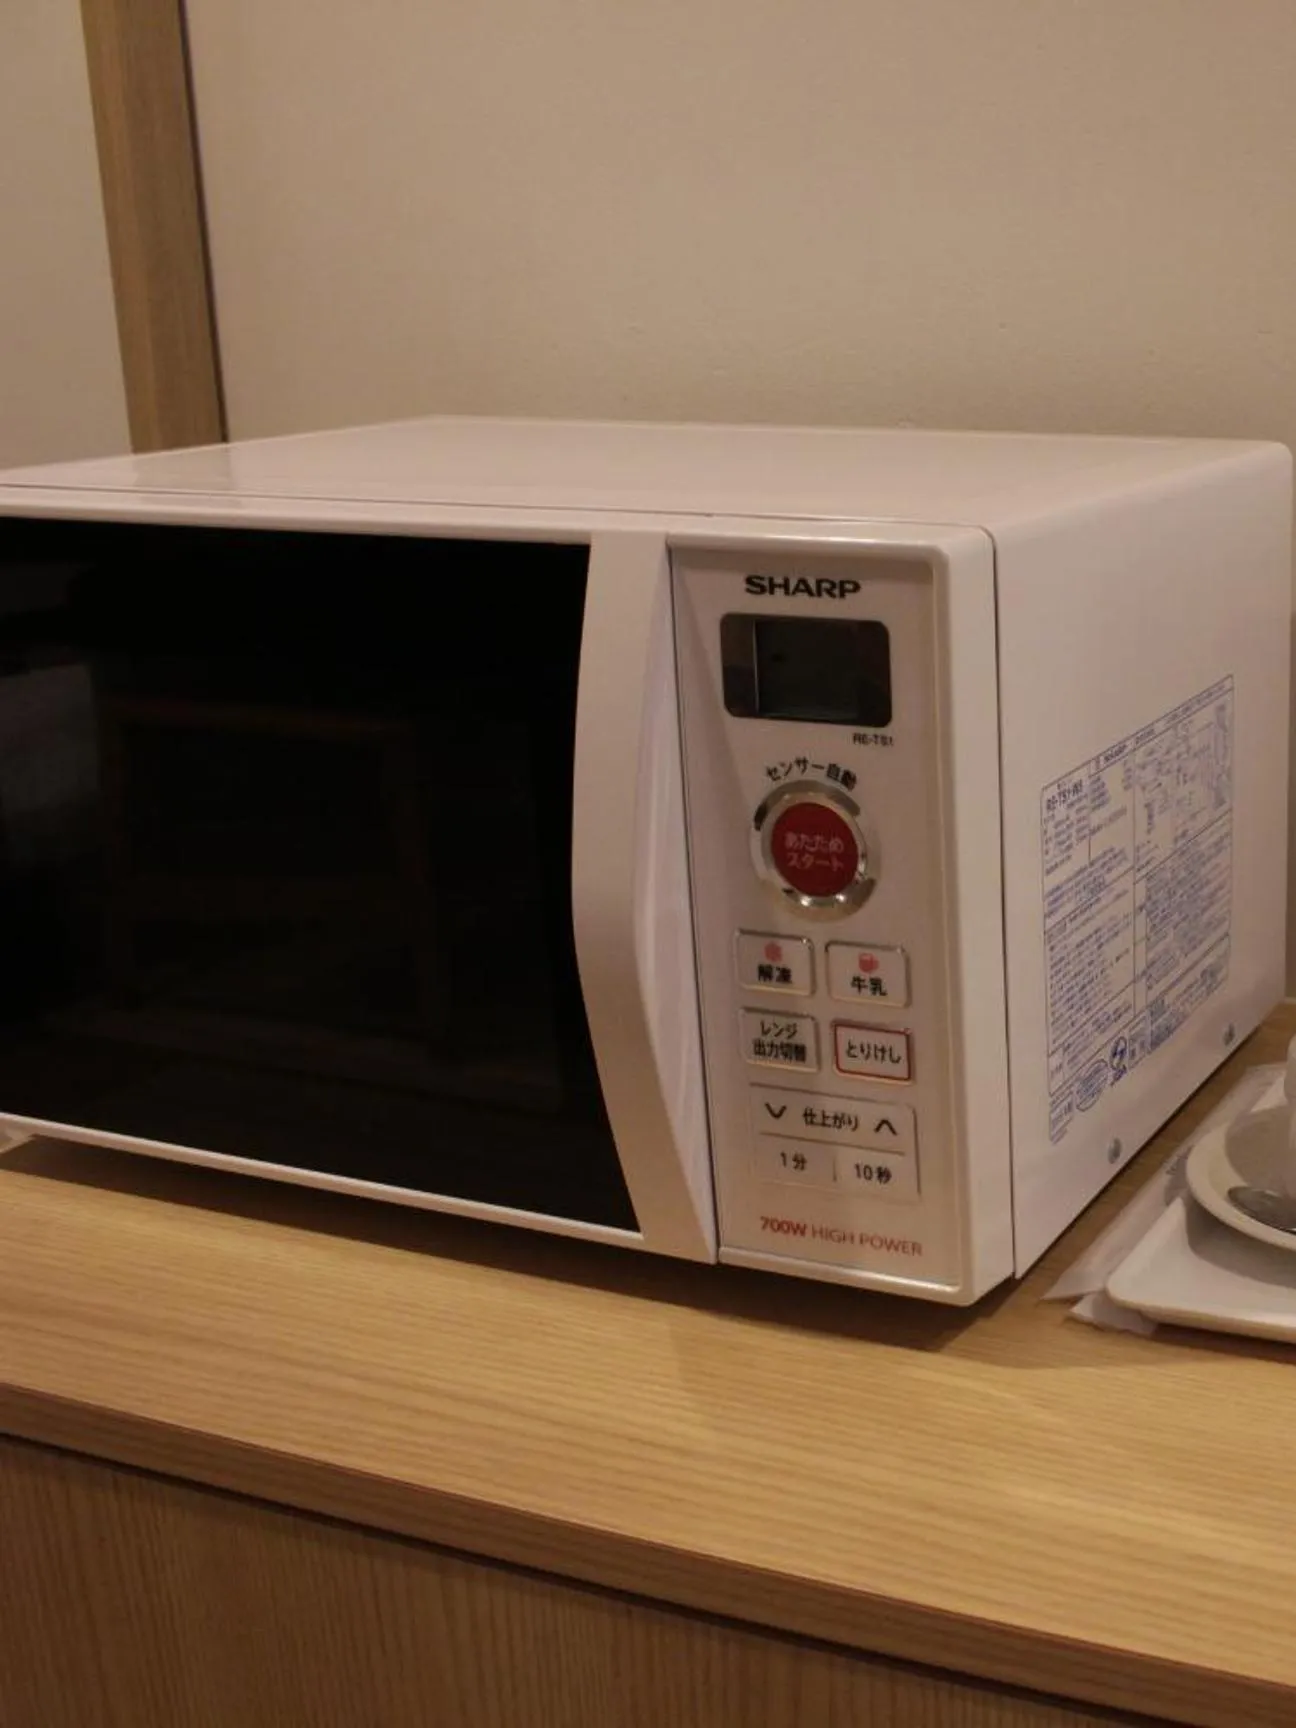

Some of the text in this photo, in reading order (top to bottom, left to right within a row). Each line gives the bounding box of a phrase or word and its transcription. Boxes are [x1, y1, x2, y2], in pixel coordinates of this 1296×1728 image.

[744, 574, 861, 599] SHARP
[765, 756, 858, 792] センサー自動
[784, 831, 844, 854] あたため
[786, 852, 845, 872] スタート
[850, 974, 888, 997] 牛乳
[759, 1019, 798, 1040] レンジ
[846, 1039, 902, 1065] とりけし
[802, 1106, 860, 1132] 仕上がり
[760, 1215, 924, 1257] 700W HIGH POWER
